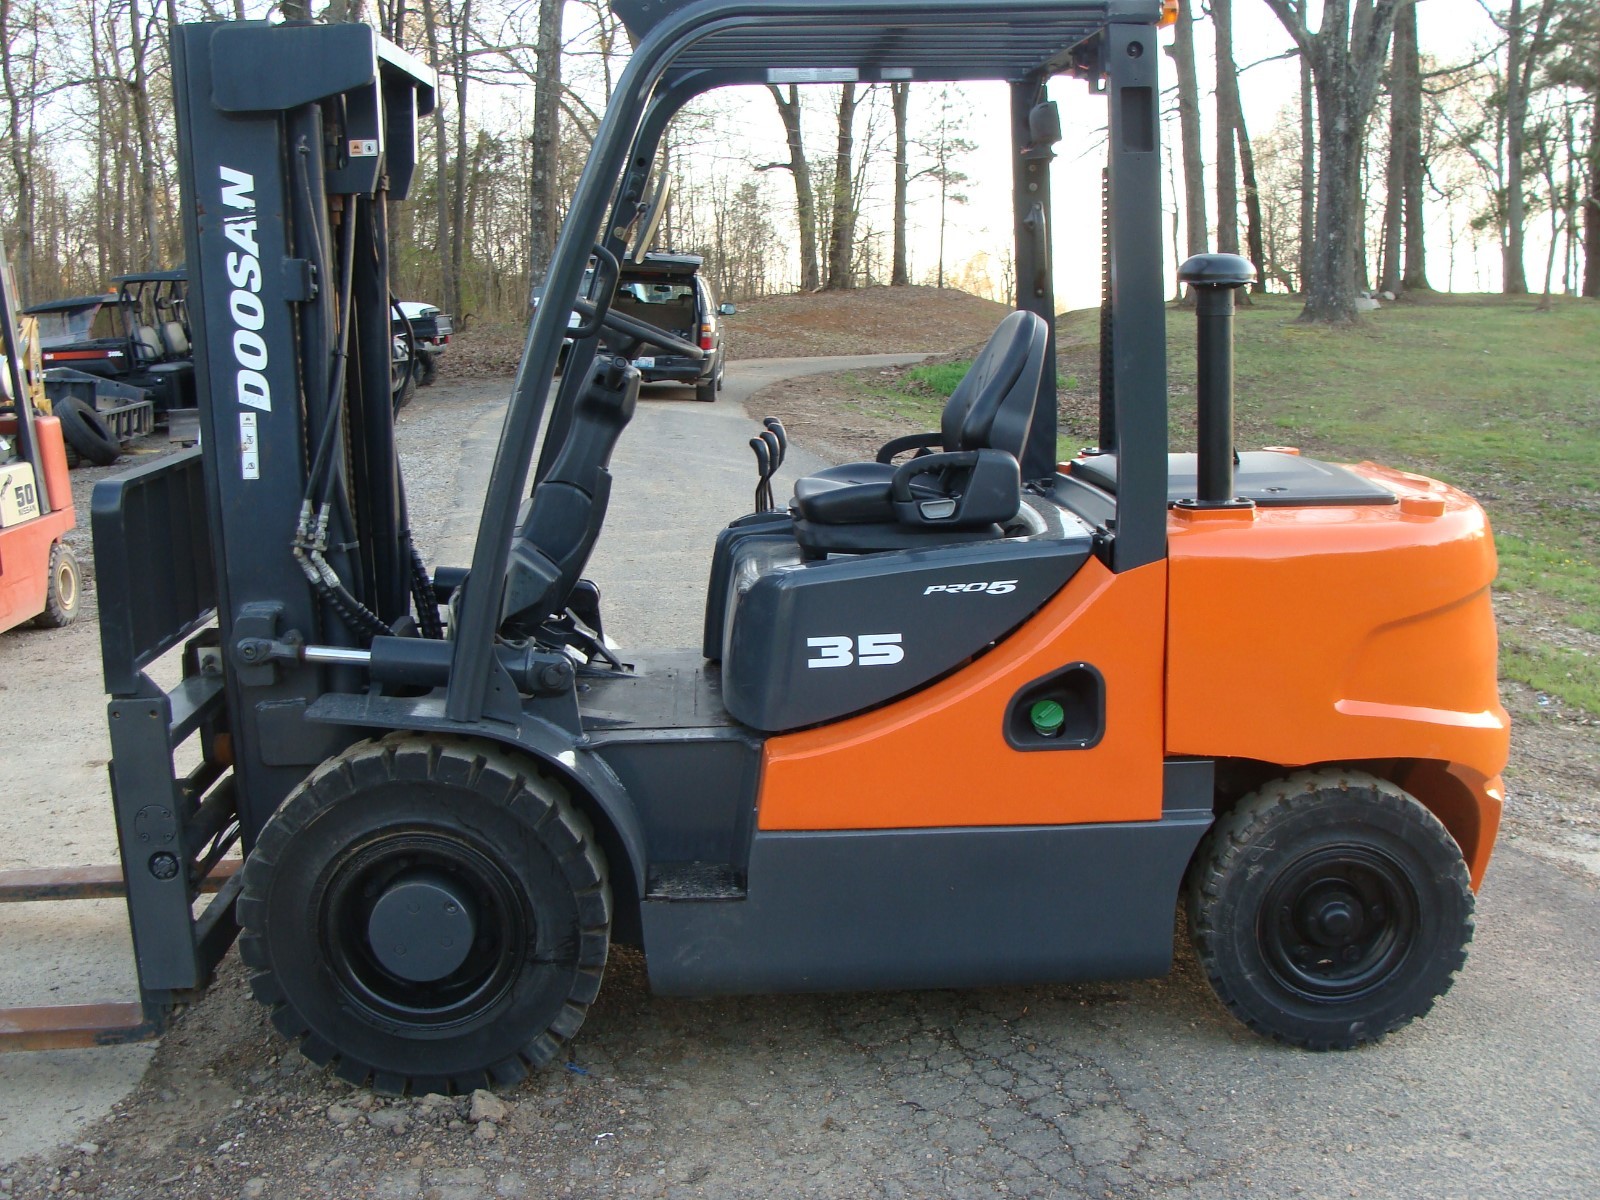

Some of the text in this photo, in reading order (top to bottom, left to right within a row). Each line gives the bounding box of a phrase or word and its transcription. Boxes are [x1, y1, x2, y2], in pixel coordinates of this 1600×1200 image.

[219, 166, 272, 412] DOOSAN
[14, 483, 35, 508] 50
[923, 579, 1018, 596] PRO5
[806, 633, 905, 669] 35
